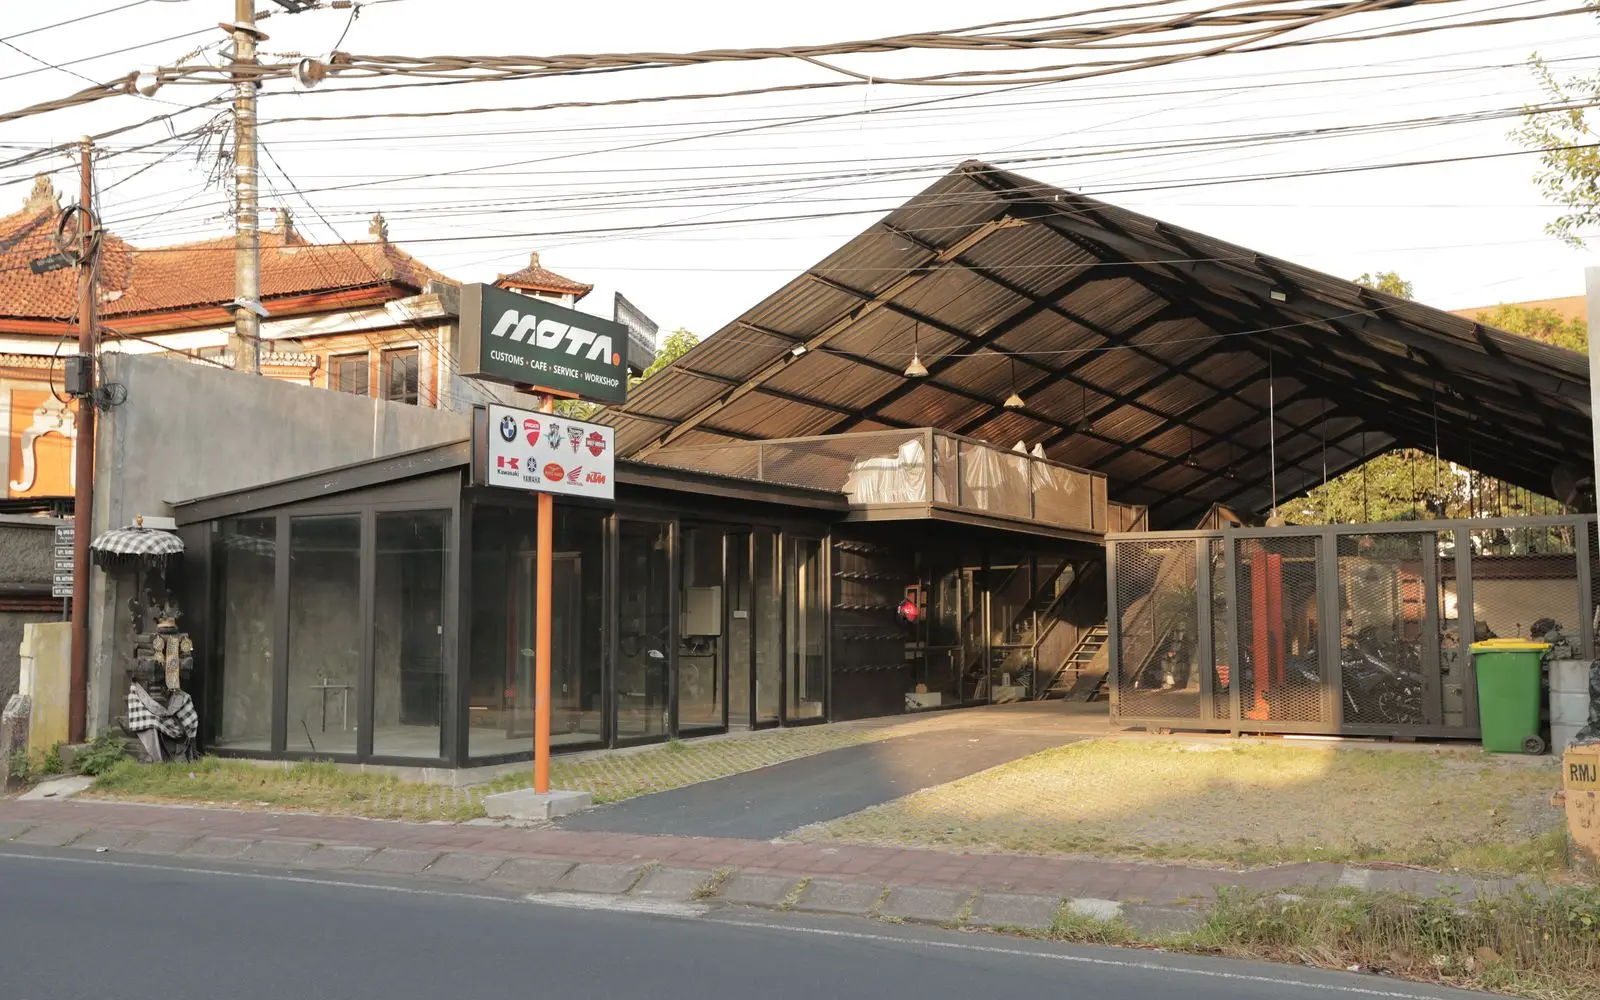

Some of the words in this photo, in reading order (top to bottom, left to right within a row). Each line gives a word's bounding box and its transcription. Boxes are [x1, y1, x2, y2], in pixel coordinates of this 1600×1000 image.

[490, 350, 524, 366] CUSTOMS
[530, 359, 548, 372] CAFE
[553, 364, 579, 379] SERVICE
[584, 372, 620, 388] WORKSHOP
[497, 469, 520, 477] Kawasaki
[586, 471, 606, 485] KTM
[1569, 763, 1597, 782] RMJ
